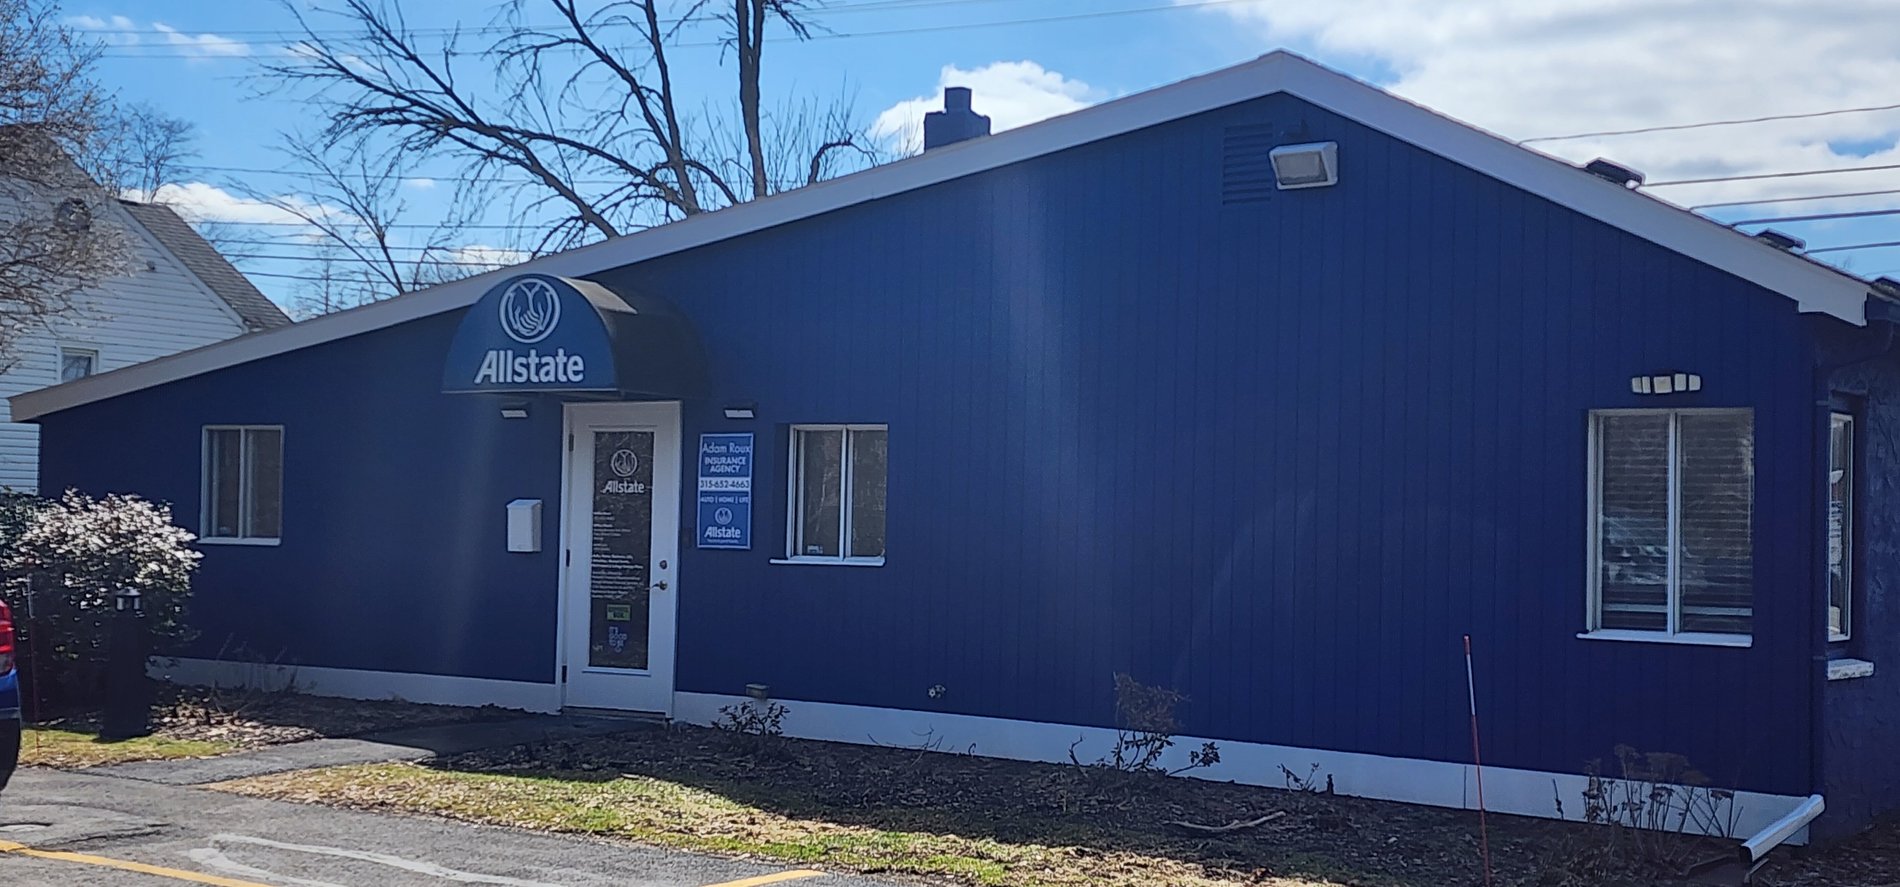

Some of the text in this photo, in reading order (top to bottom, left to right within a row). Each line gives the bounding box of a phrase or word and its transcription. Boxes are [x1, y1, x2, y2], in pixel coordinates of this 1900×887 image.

[474, 348, 585, 384] Allstate
[703, 441, 751, 454] Adam Roux
[704, 456, 746, 465] INSURANCE
[710, 465, 740, 473] AGENCY
[602, 480, 645, 494] Allstate
[700, 479, 750, 489] 315-652-4663
[704, 526, 741, 538] Allstate
